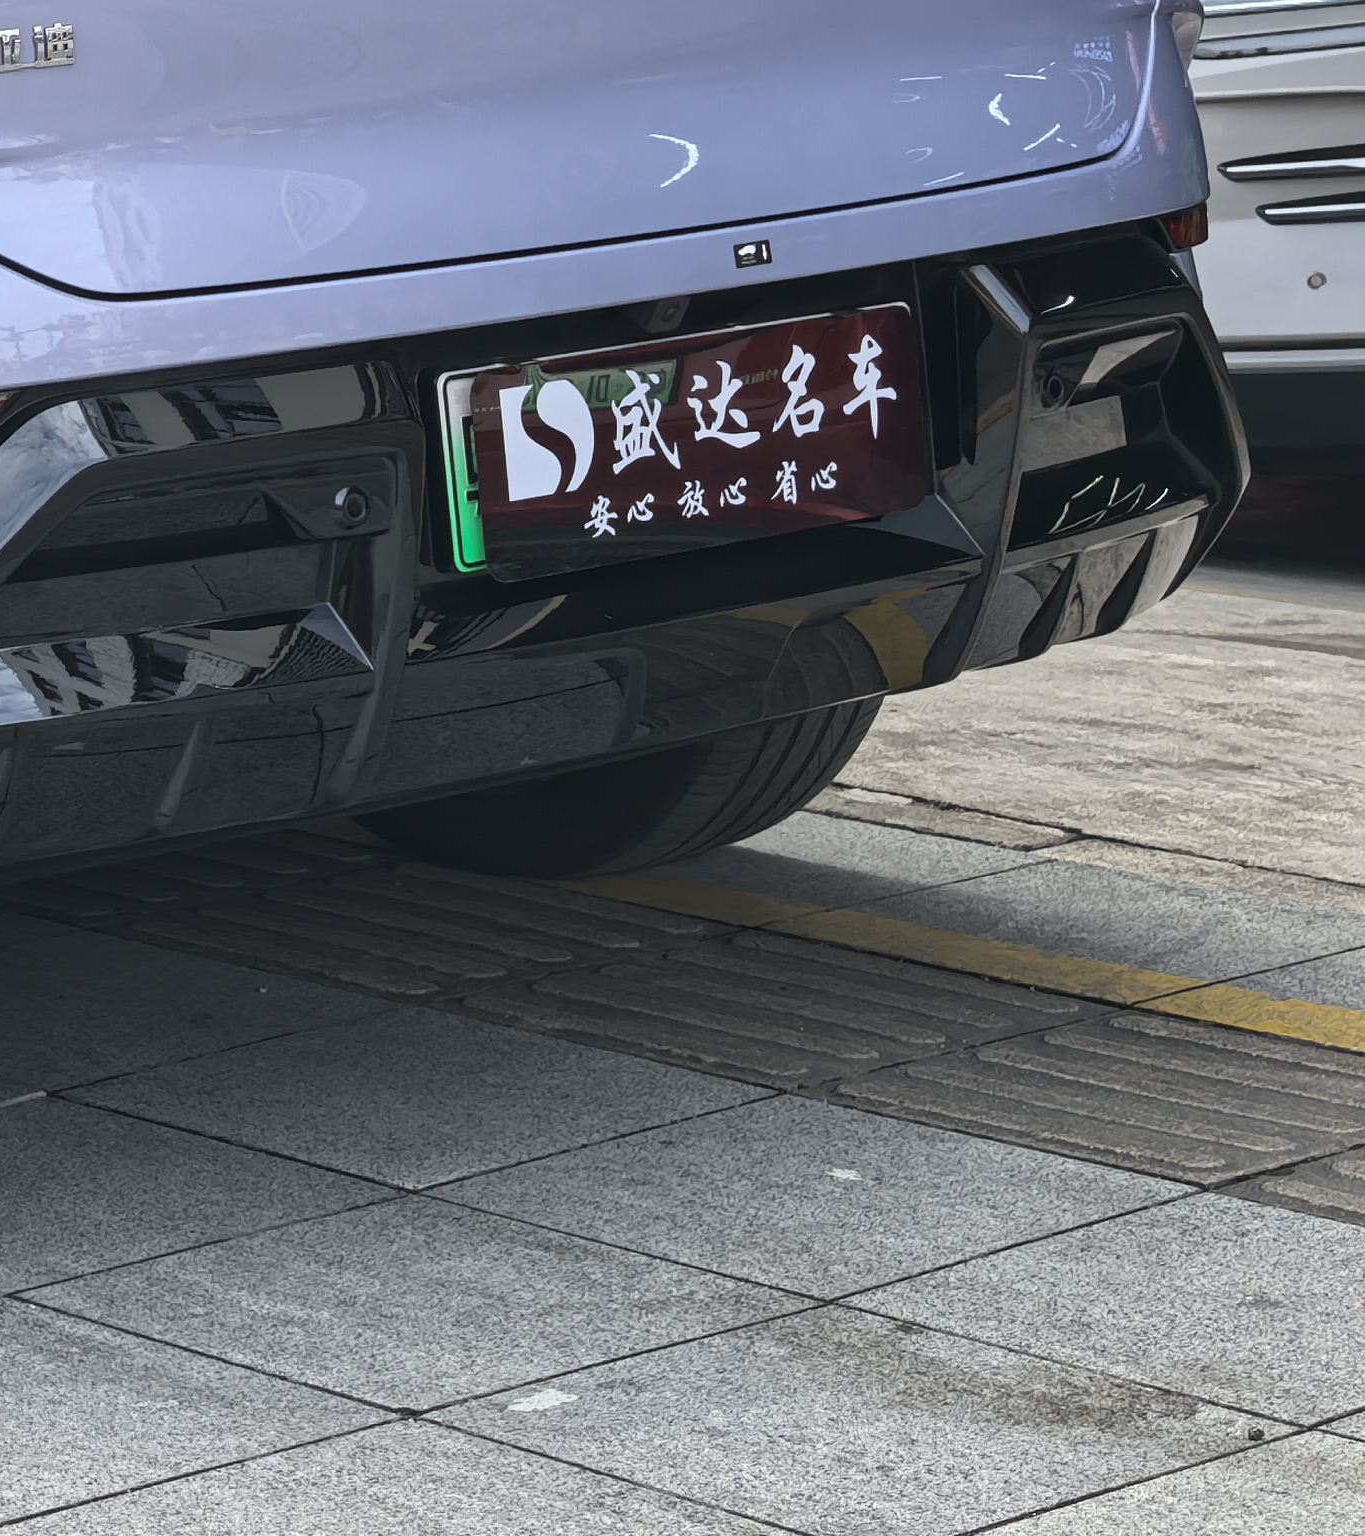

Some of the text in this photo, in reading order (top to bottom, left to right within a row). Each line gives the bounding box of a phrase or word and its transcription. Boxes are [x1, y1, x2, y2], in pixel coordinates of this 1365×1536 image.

[611, 334, 898, 476] 盛达名车
[584, 460, 838, 538] 安心 放心 省心
